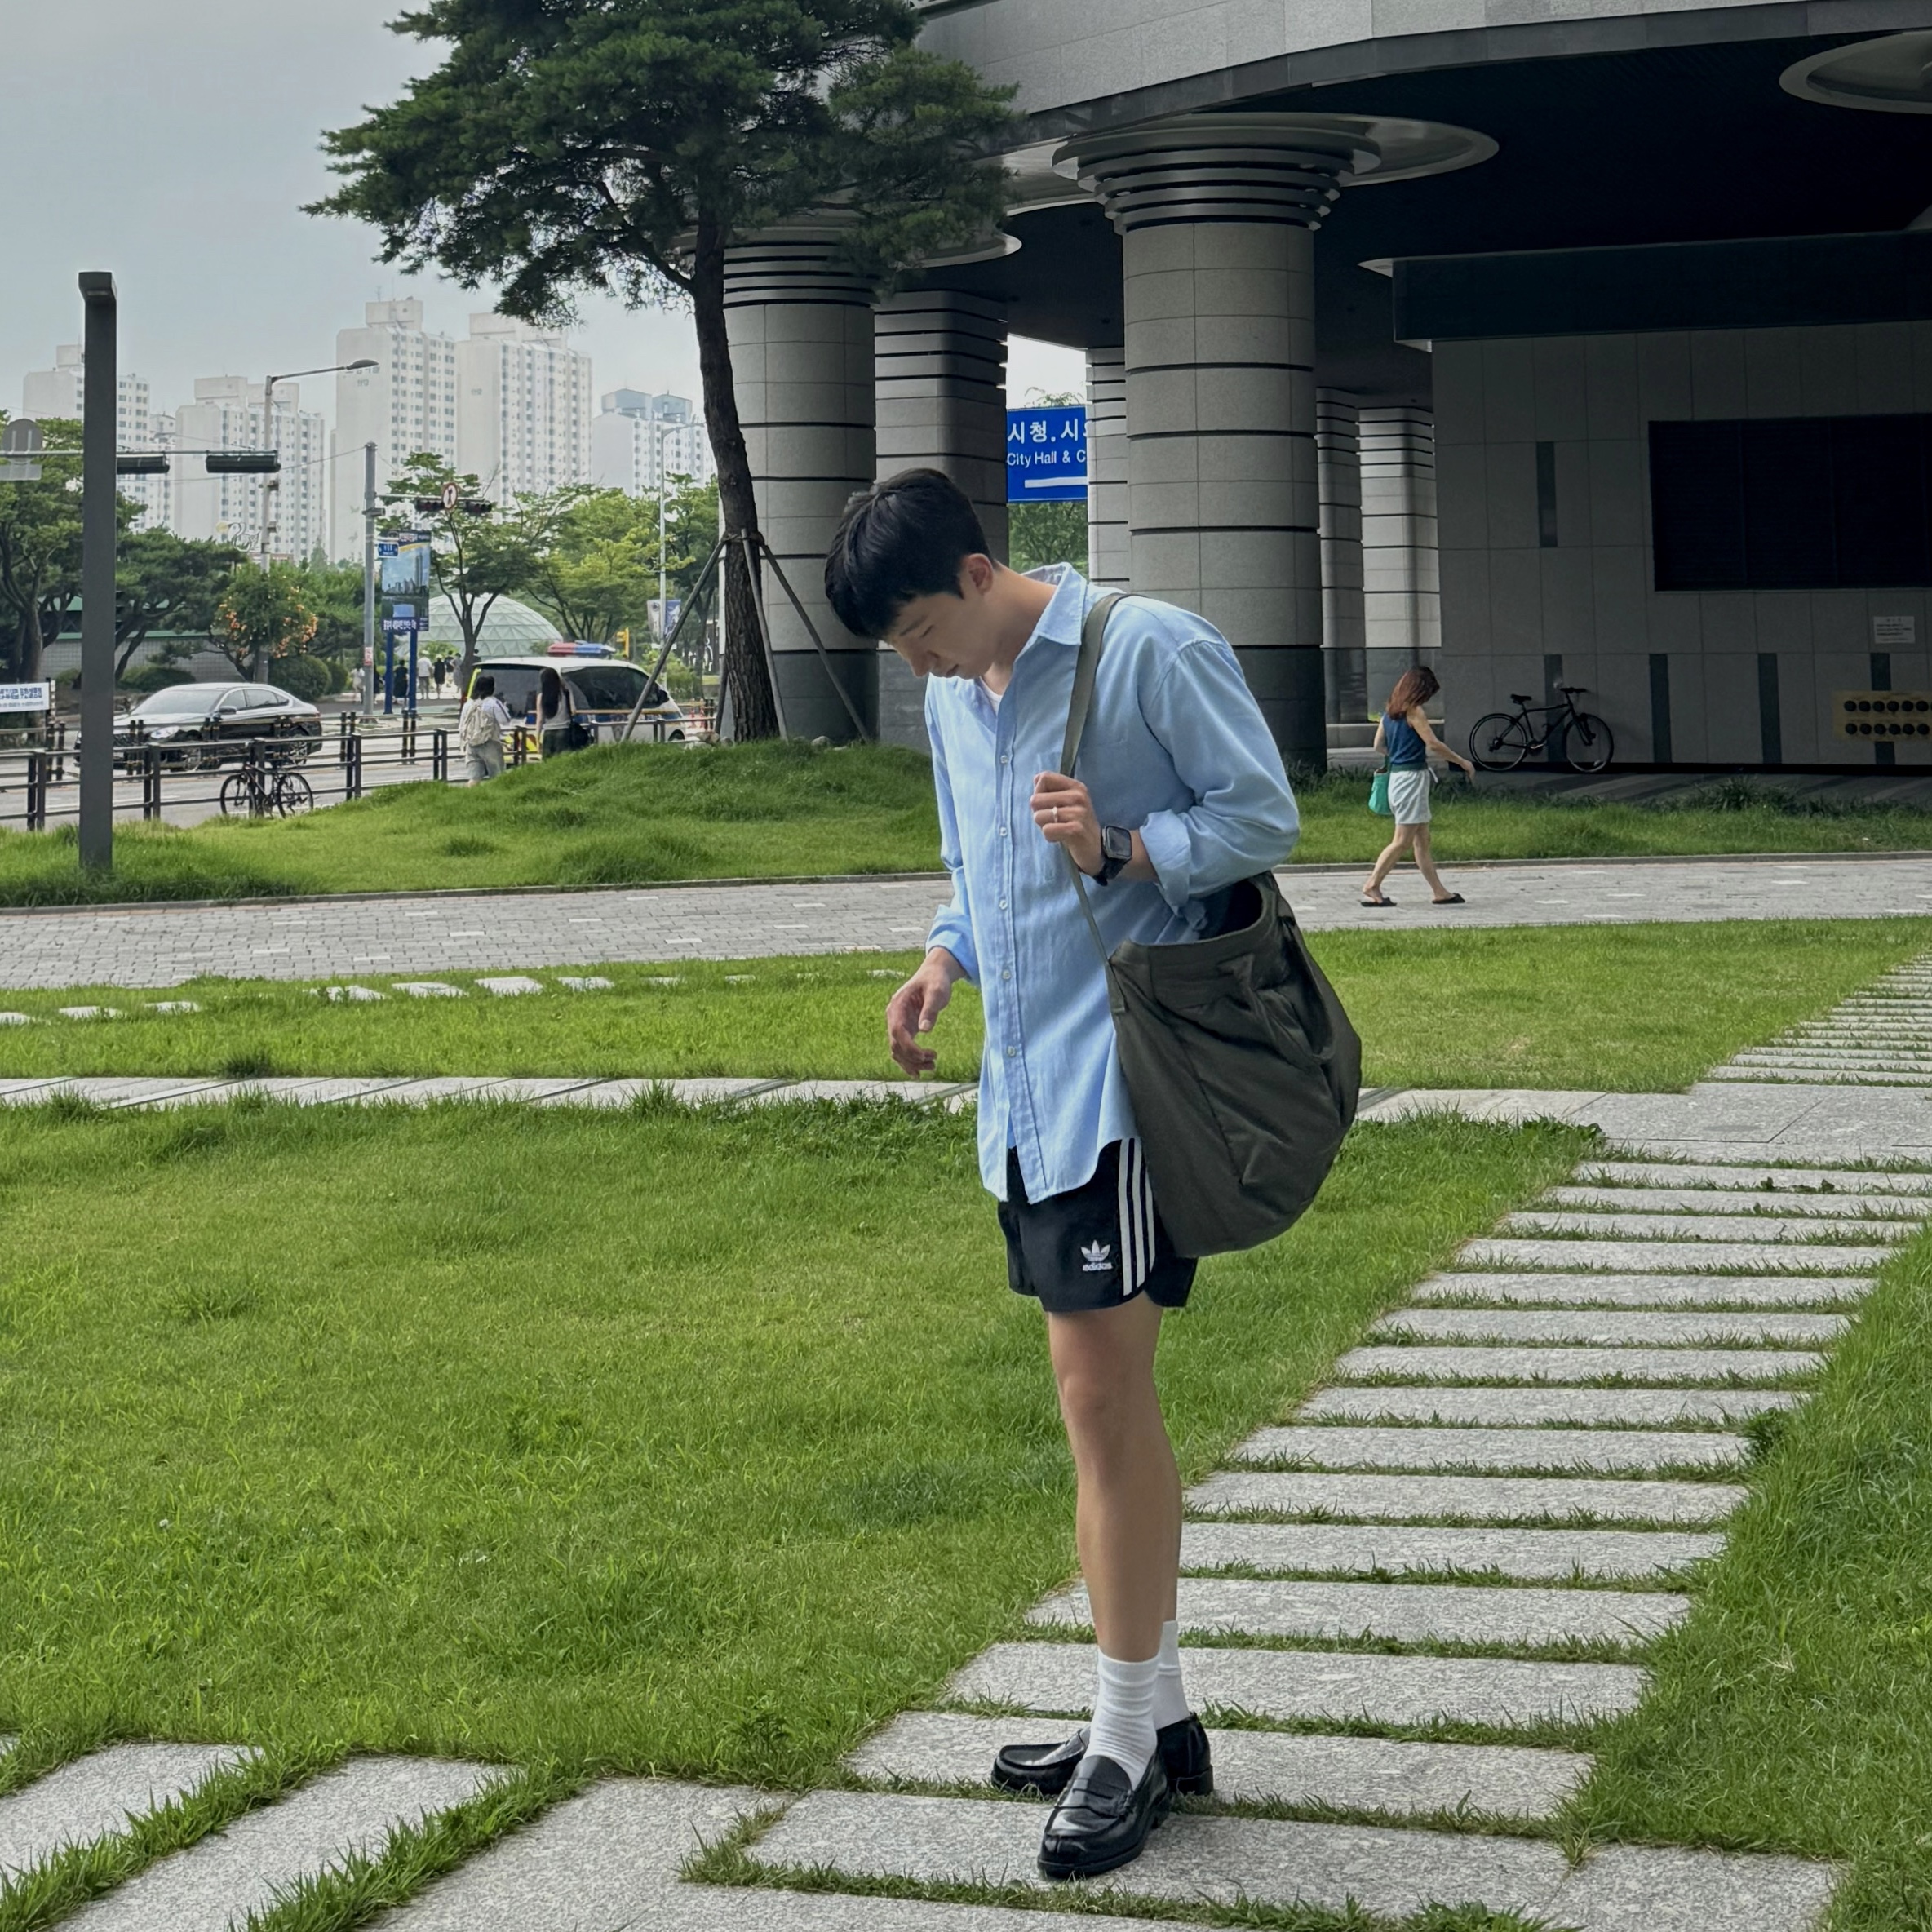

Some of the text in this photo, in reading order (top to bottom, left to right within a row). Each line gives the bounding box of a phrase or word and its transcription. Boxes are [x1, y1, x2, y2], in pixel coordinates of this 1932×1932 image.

[1007, 418, 1088, 445] 시청.시
[1007, 452, 1031, 468] City
[1035, 450, 1057, 465] Hall
[1061, 450, 1071, 463] &
